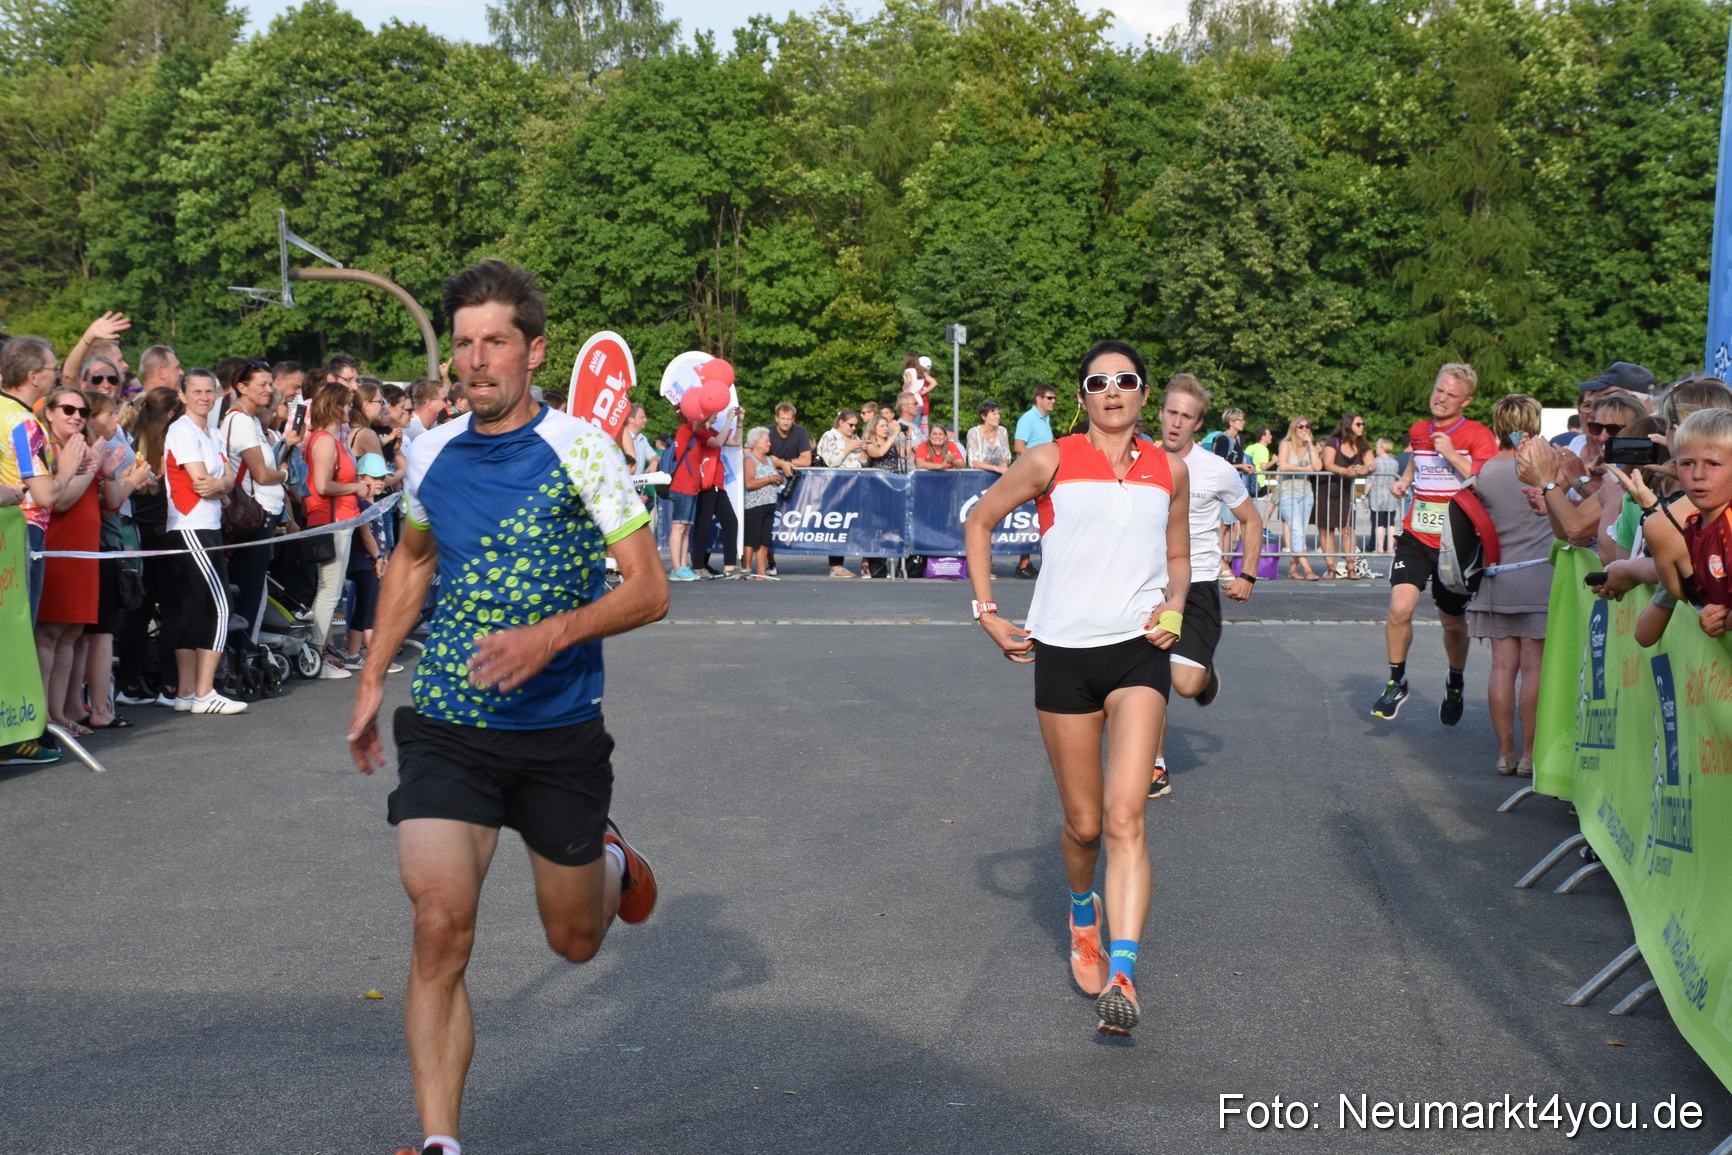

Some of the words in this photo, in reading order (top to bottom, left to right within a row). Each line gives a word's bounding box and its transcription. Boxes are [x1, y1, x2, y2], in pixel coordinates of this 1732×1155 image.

[1420, 465, 1455, 475] Petry
[1416, 511, 1445, 526] 1825
[771, 531, 847, 543] TOMOBILE
